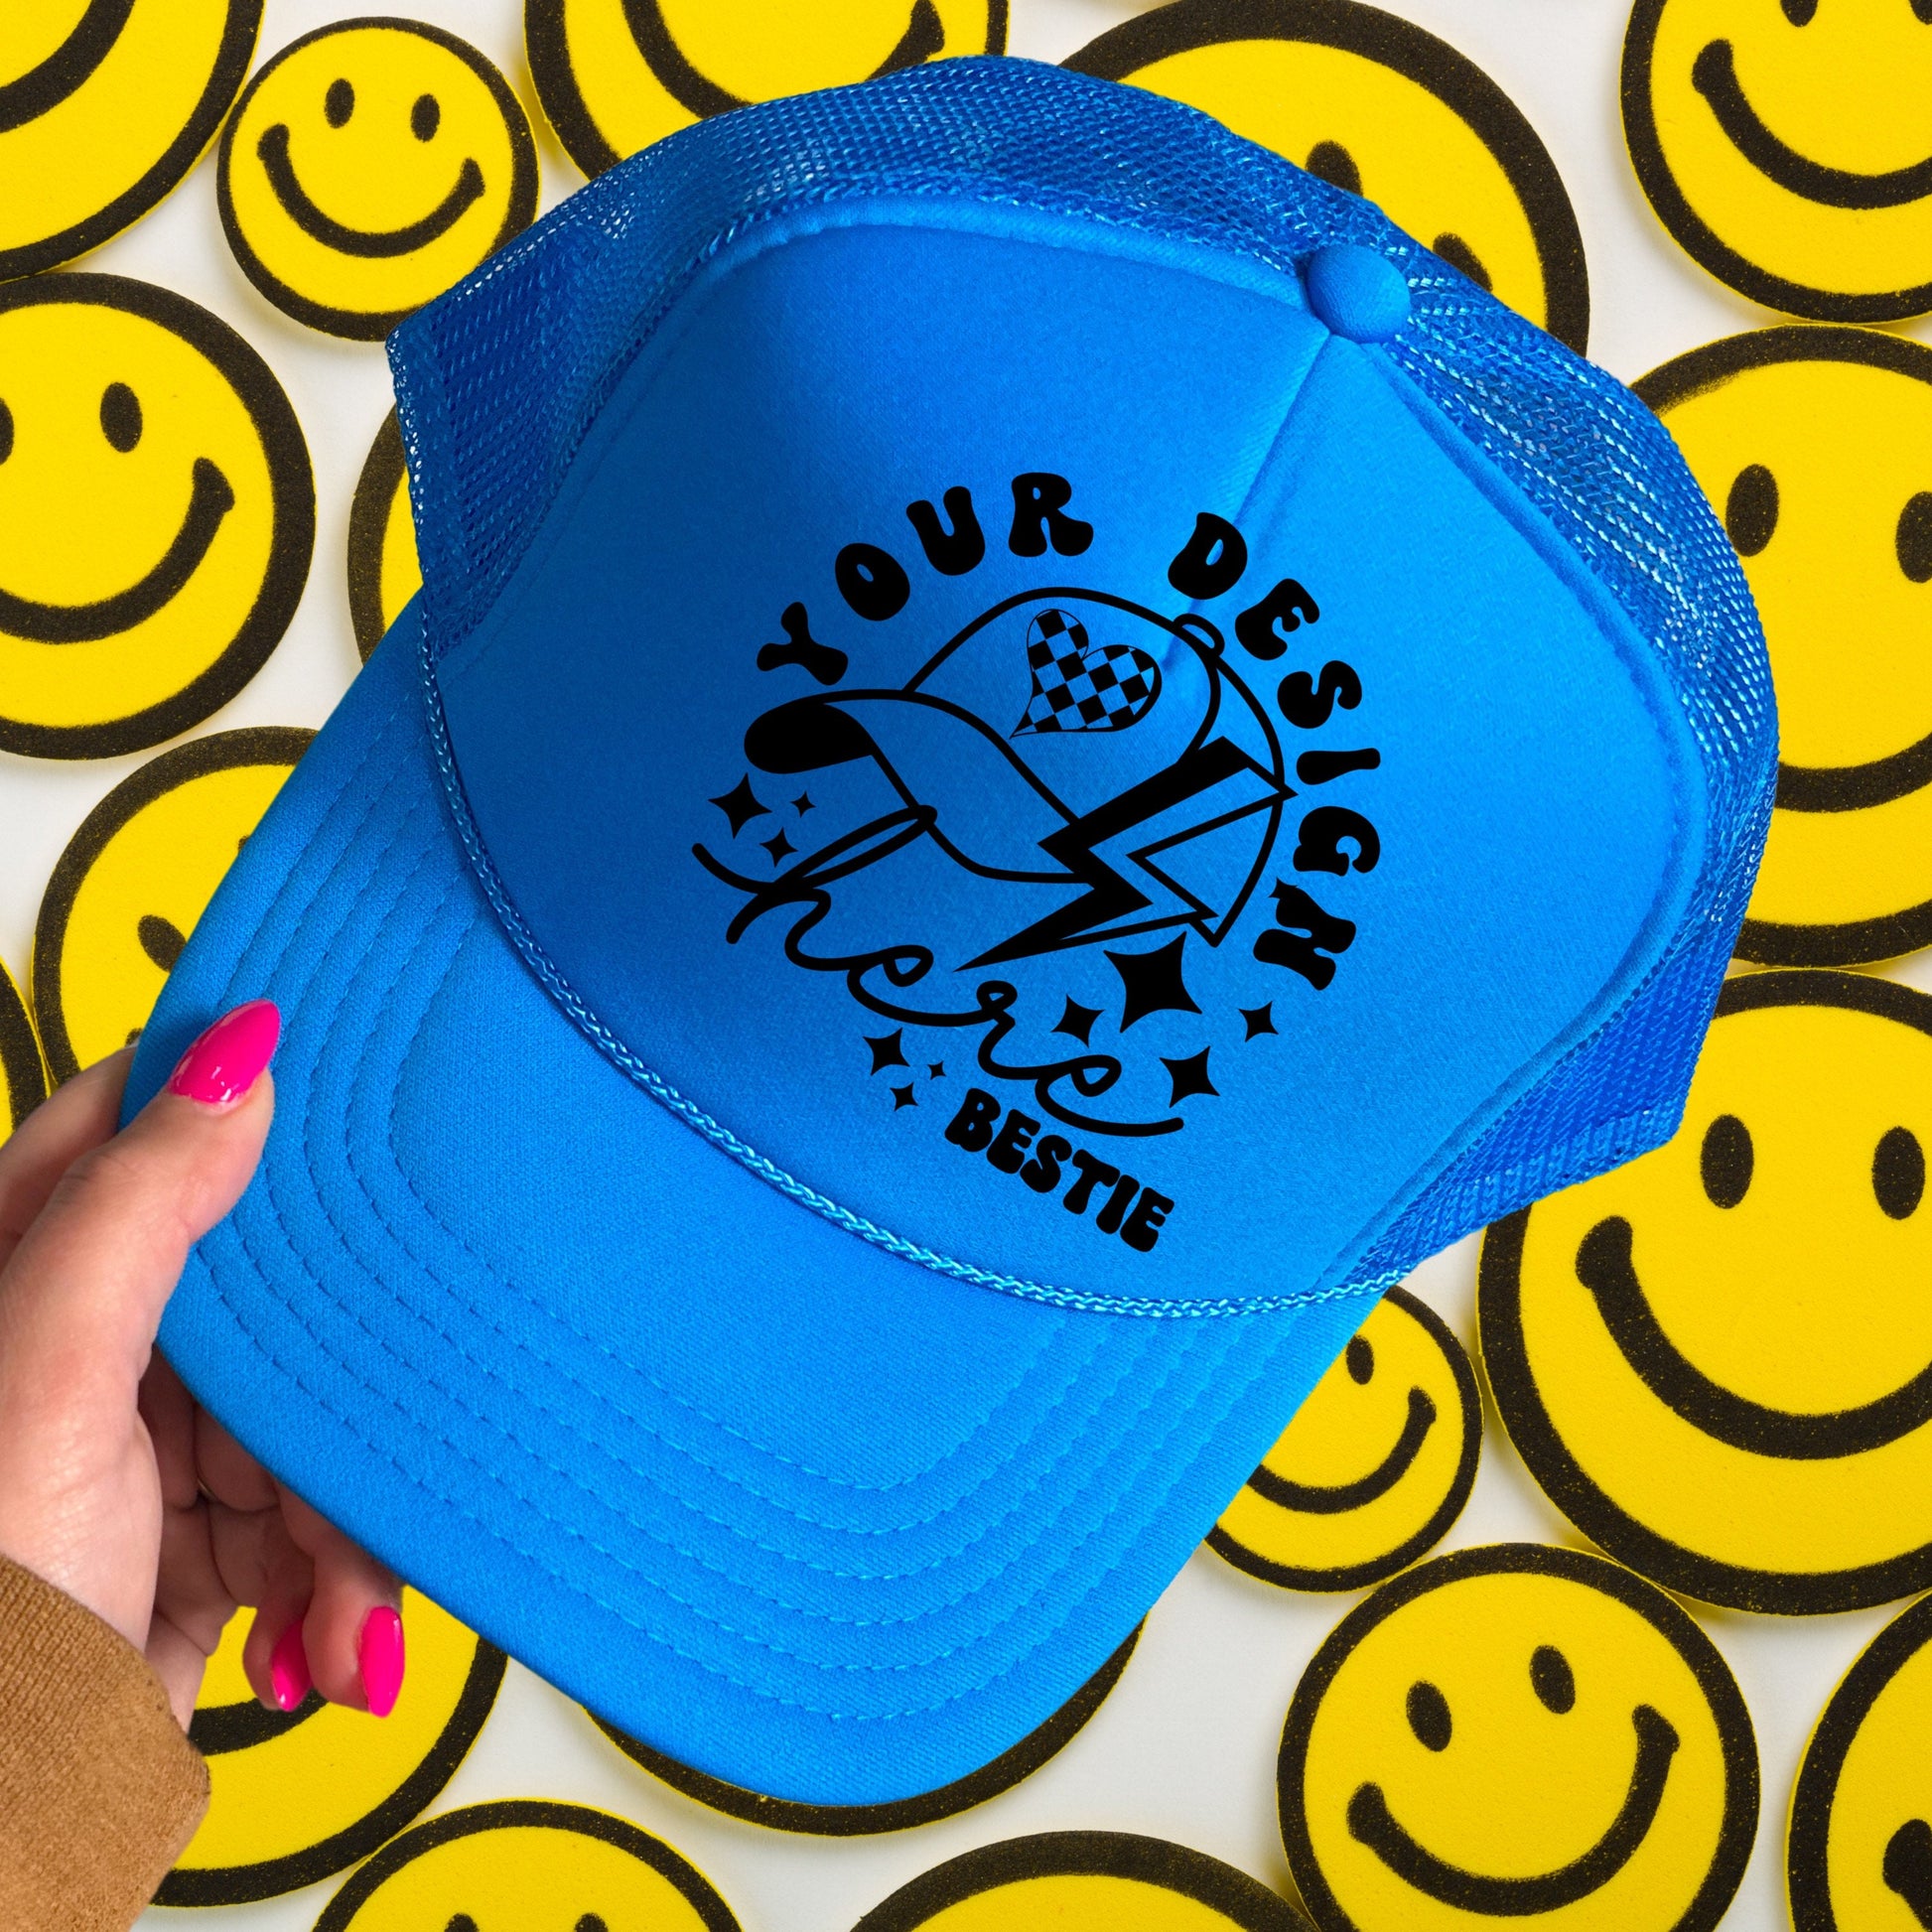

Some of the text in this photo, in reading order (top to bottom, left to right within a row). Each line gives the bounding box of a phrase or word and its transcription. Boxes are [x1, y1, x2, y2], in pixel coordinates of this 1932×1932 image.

[756, 472, 1381, 991] YOUR DESIGN
[691, 804, 1184, 1137] here
[944, 1088, 1174, 1252] BESTIE
